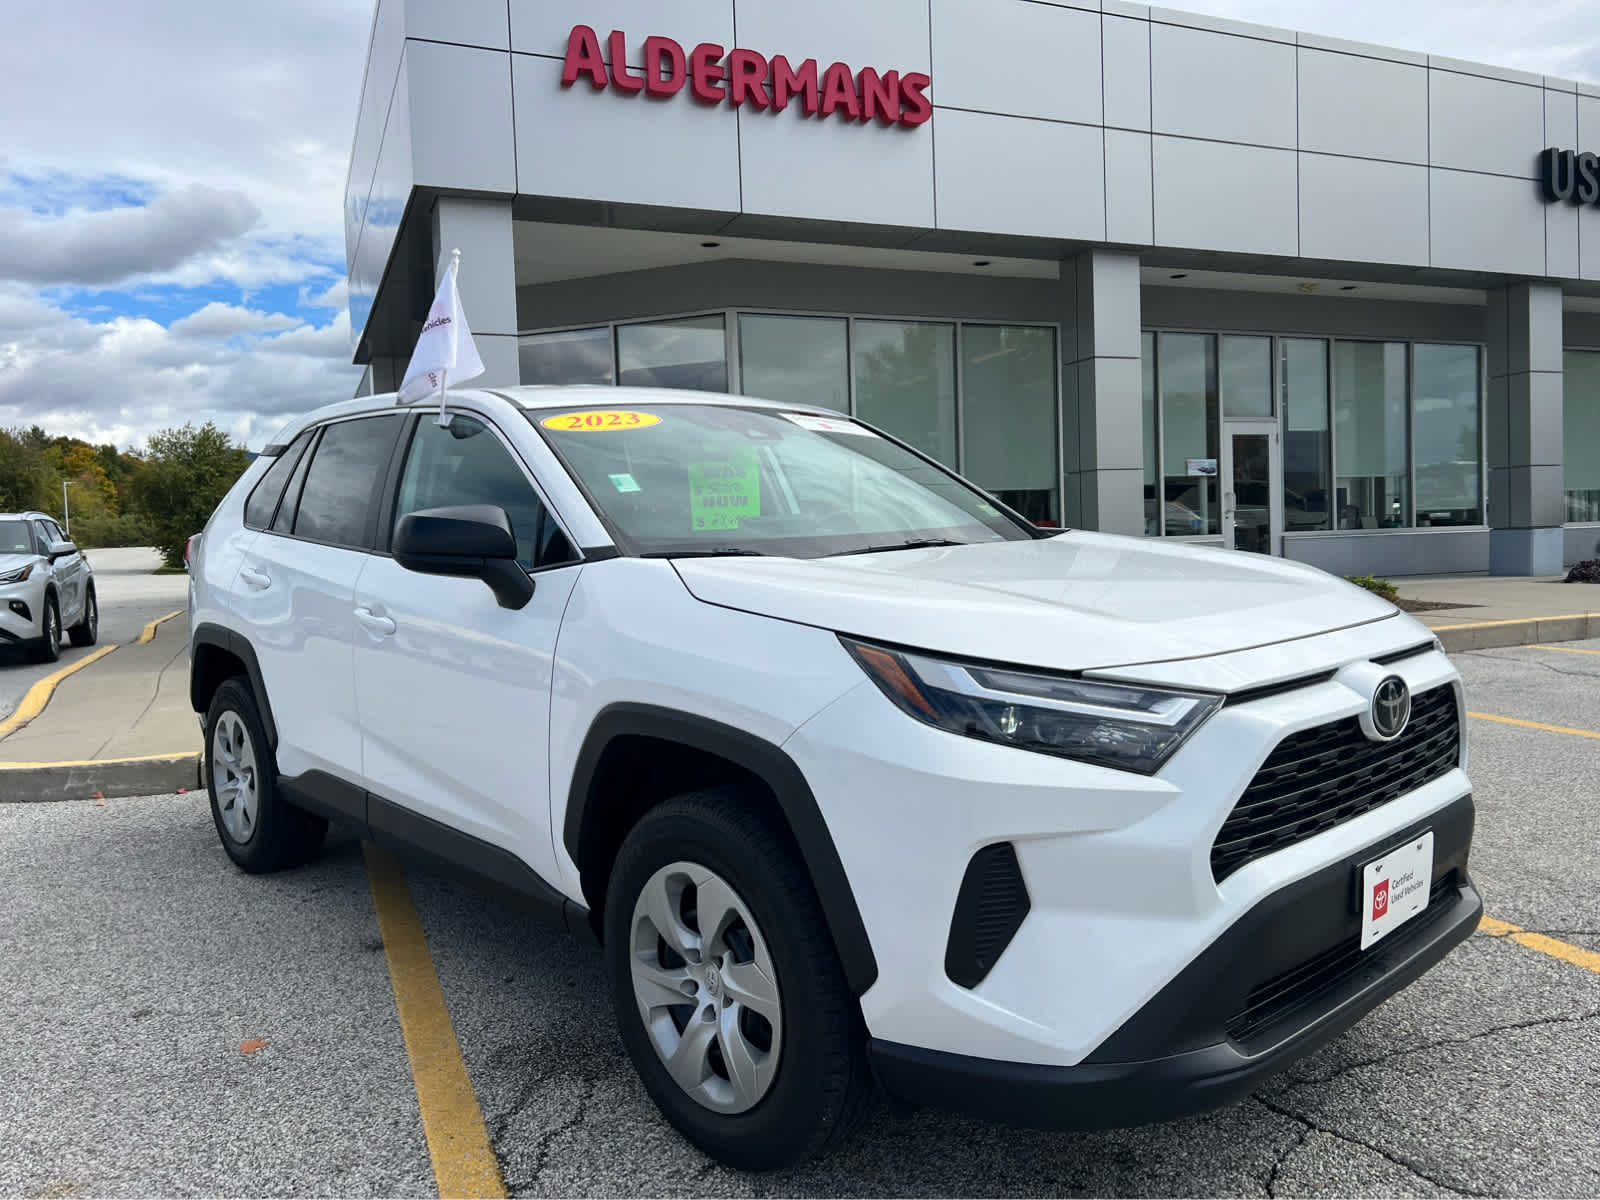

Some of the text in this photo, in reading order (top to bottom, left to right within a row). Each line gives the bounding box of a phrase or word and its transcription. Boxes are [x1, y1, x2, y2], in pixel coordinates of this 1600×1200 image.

[561, 25, 933, 128] ALDERMANS
[567, 413, 641, 429] 2023
[1391, 871, 1414, 890] Certified
[1390, 887, 1404, 904] Used
